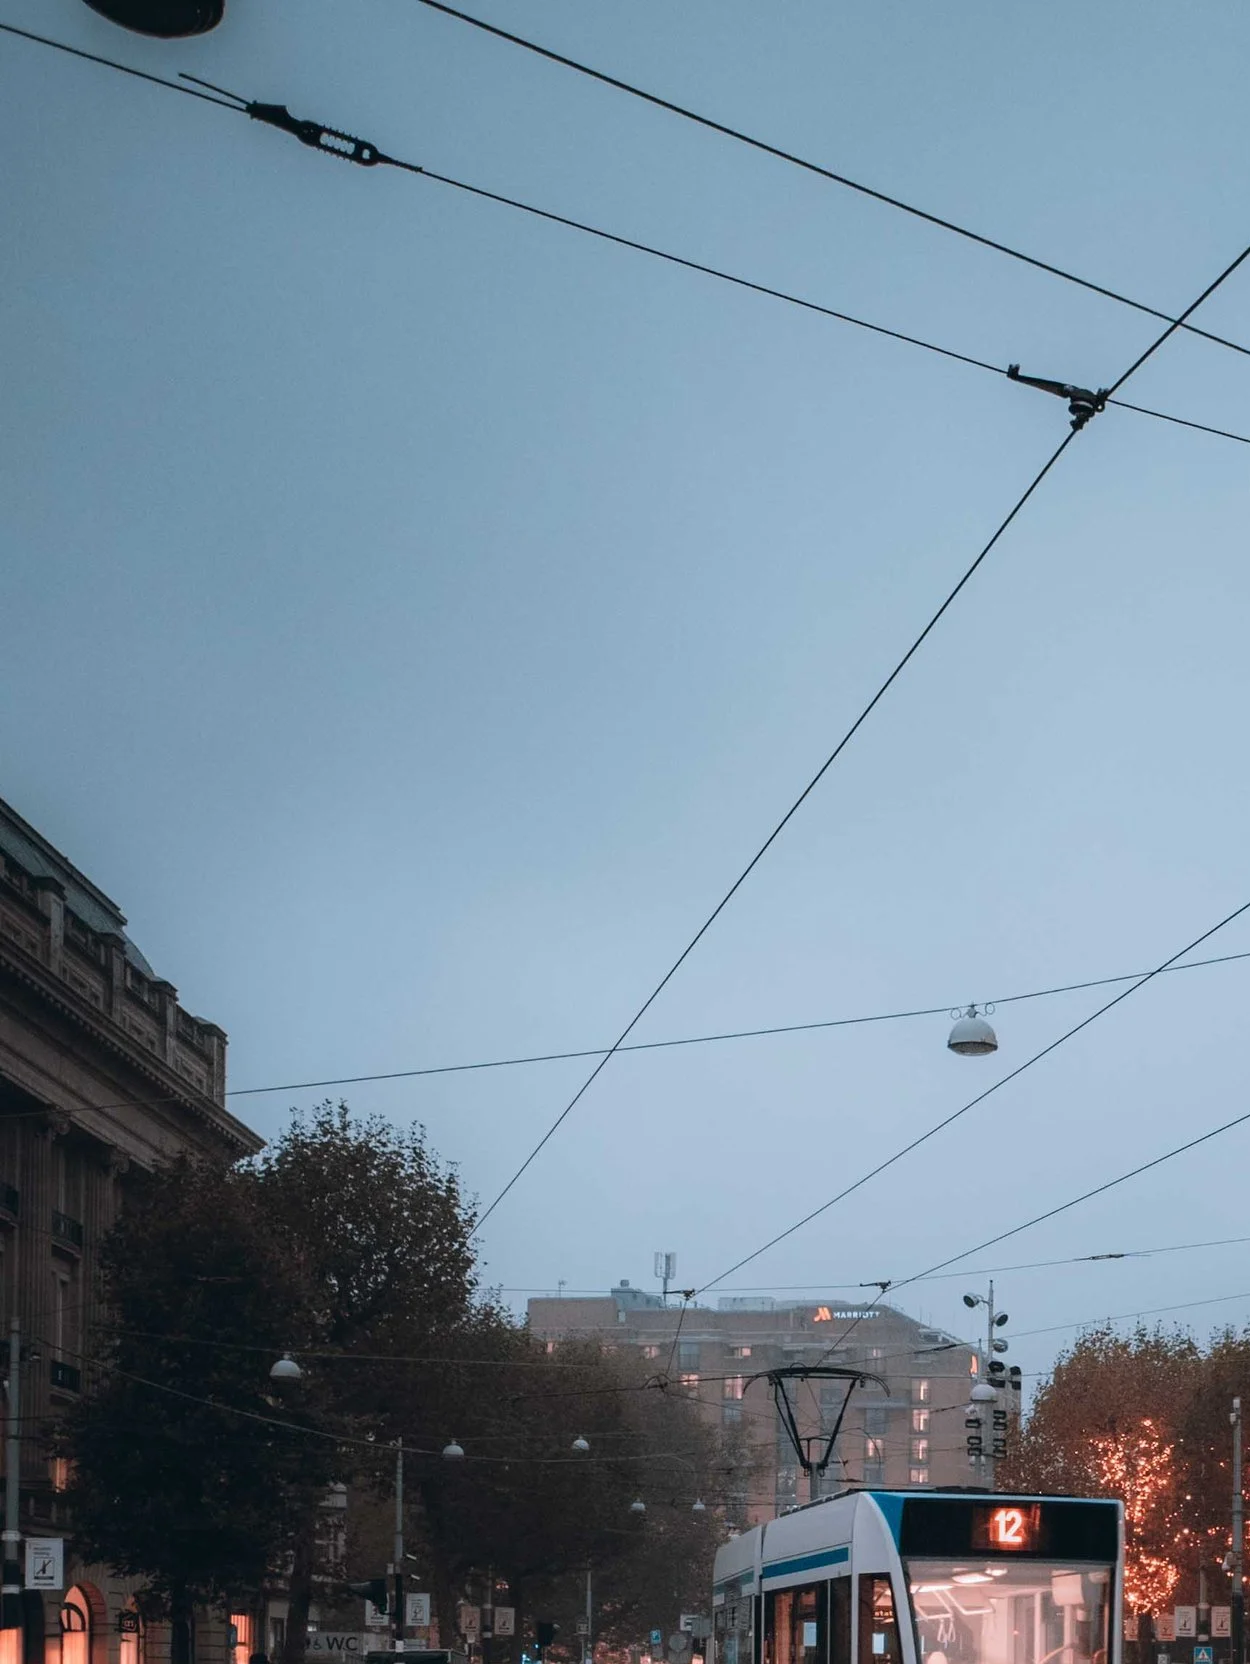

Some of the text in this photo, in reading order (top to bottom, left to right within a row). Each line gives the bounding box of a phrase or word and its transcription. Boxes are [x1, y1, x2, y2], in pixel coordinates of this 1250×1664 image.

[833, 1311, 880, 1319] MARRIOTT
[994, 1509, 1022, 1542] 12
[327, 1636, 358, 1650] WC
